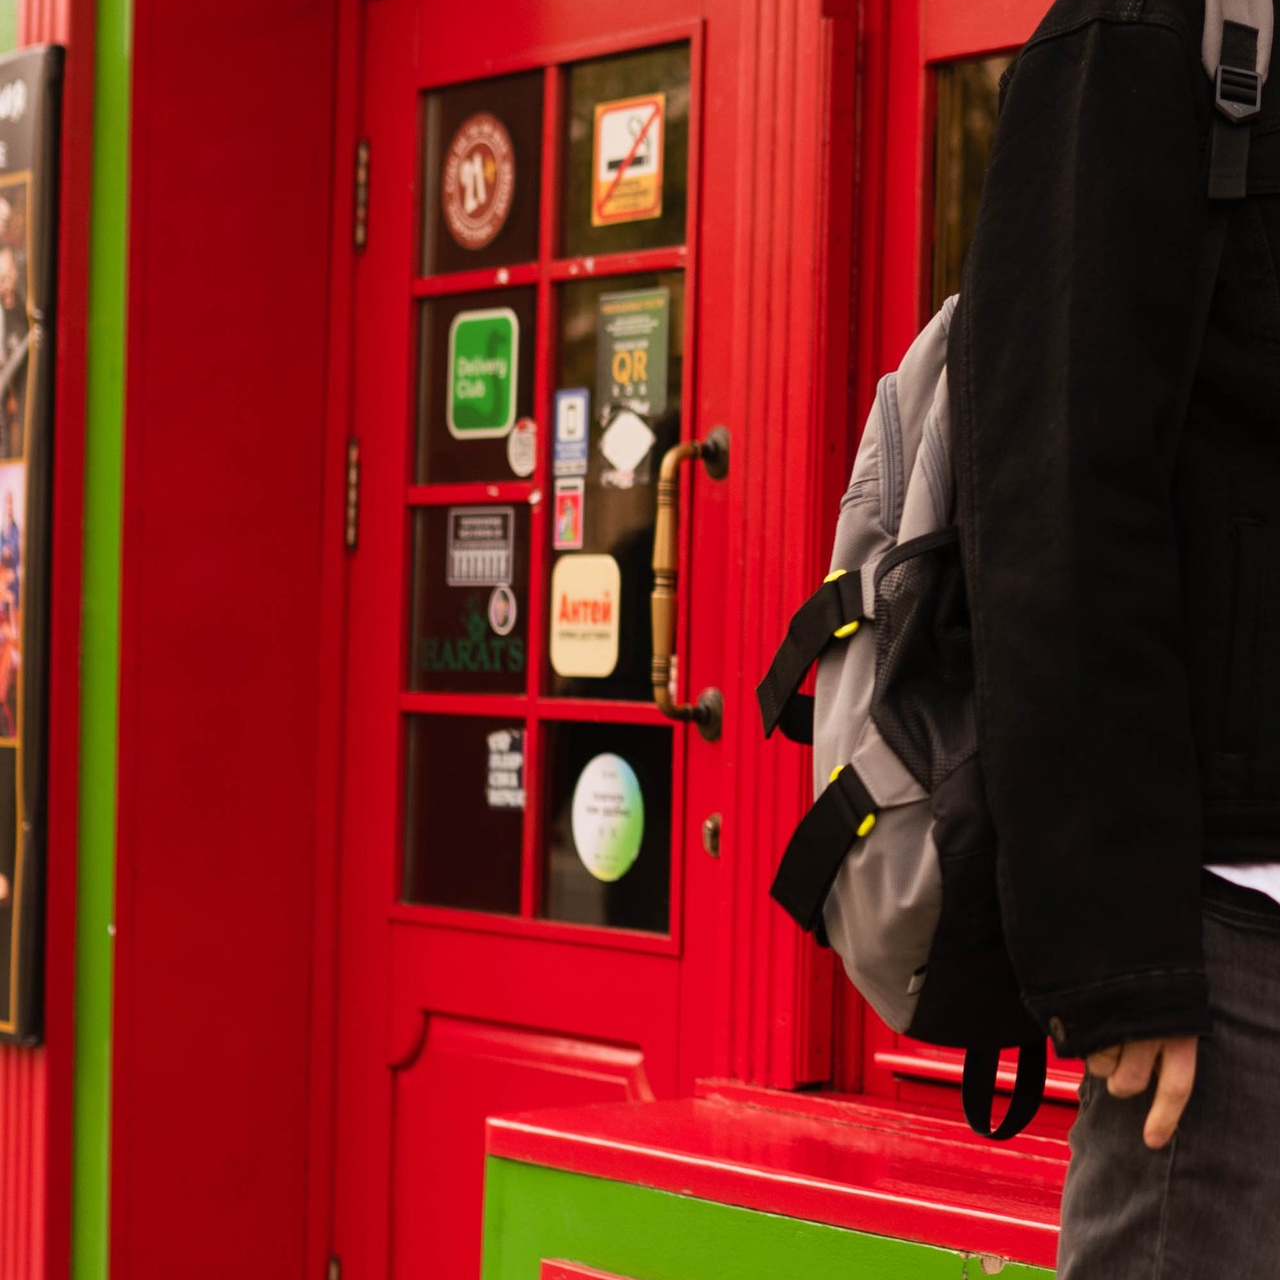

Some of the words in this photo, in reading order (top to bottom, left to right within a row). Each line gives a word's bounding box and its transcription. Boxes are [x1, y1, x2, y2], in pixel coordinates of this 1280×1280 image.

[456, 355, 508, 380] Delivery
[612, 350, 647, 384] QR
[456, 378, 486, 400] Club
[559, 591, 612, 624] Антей
